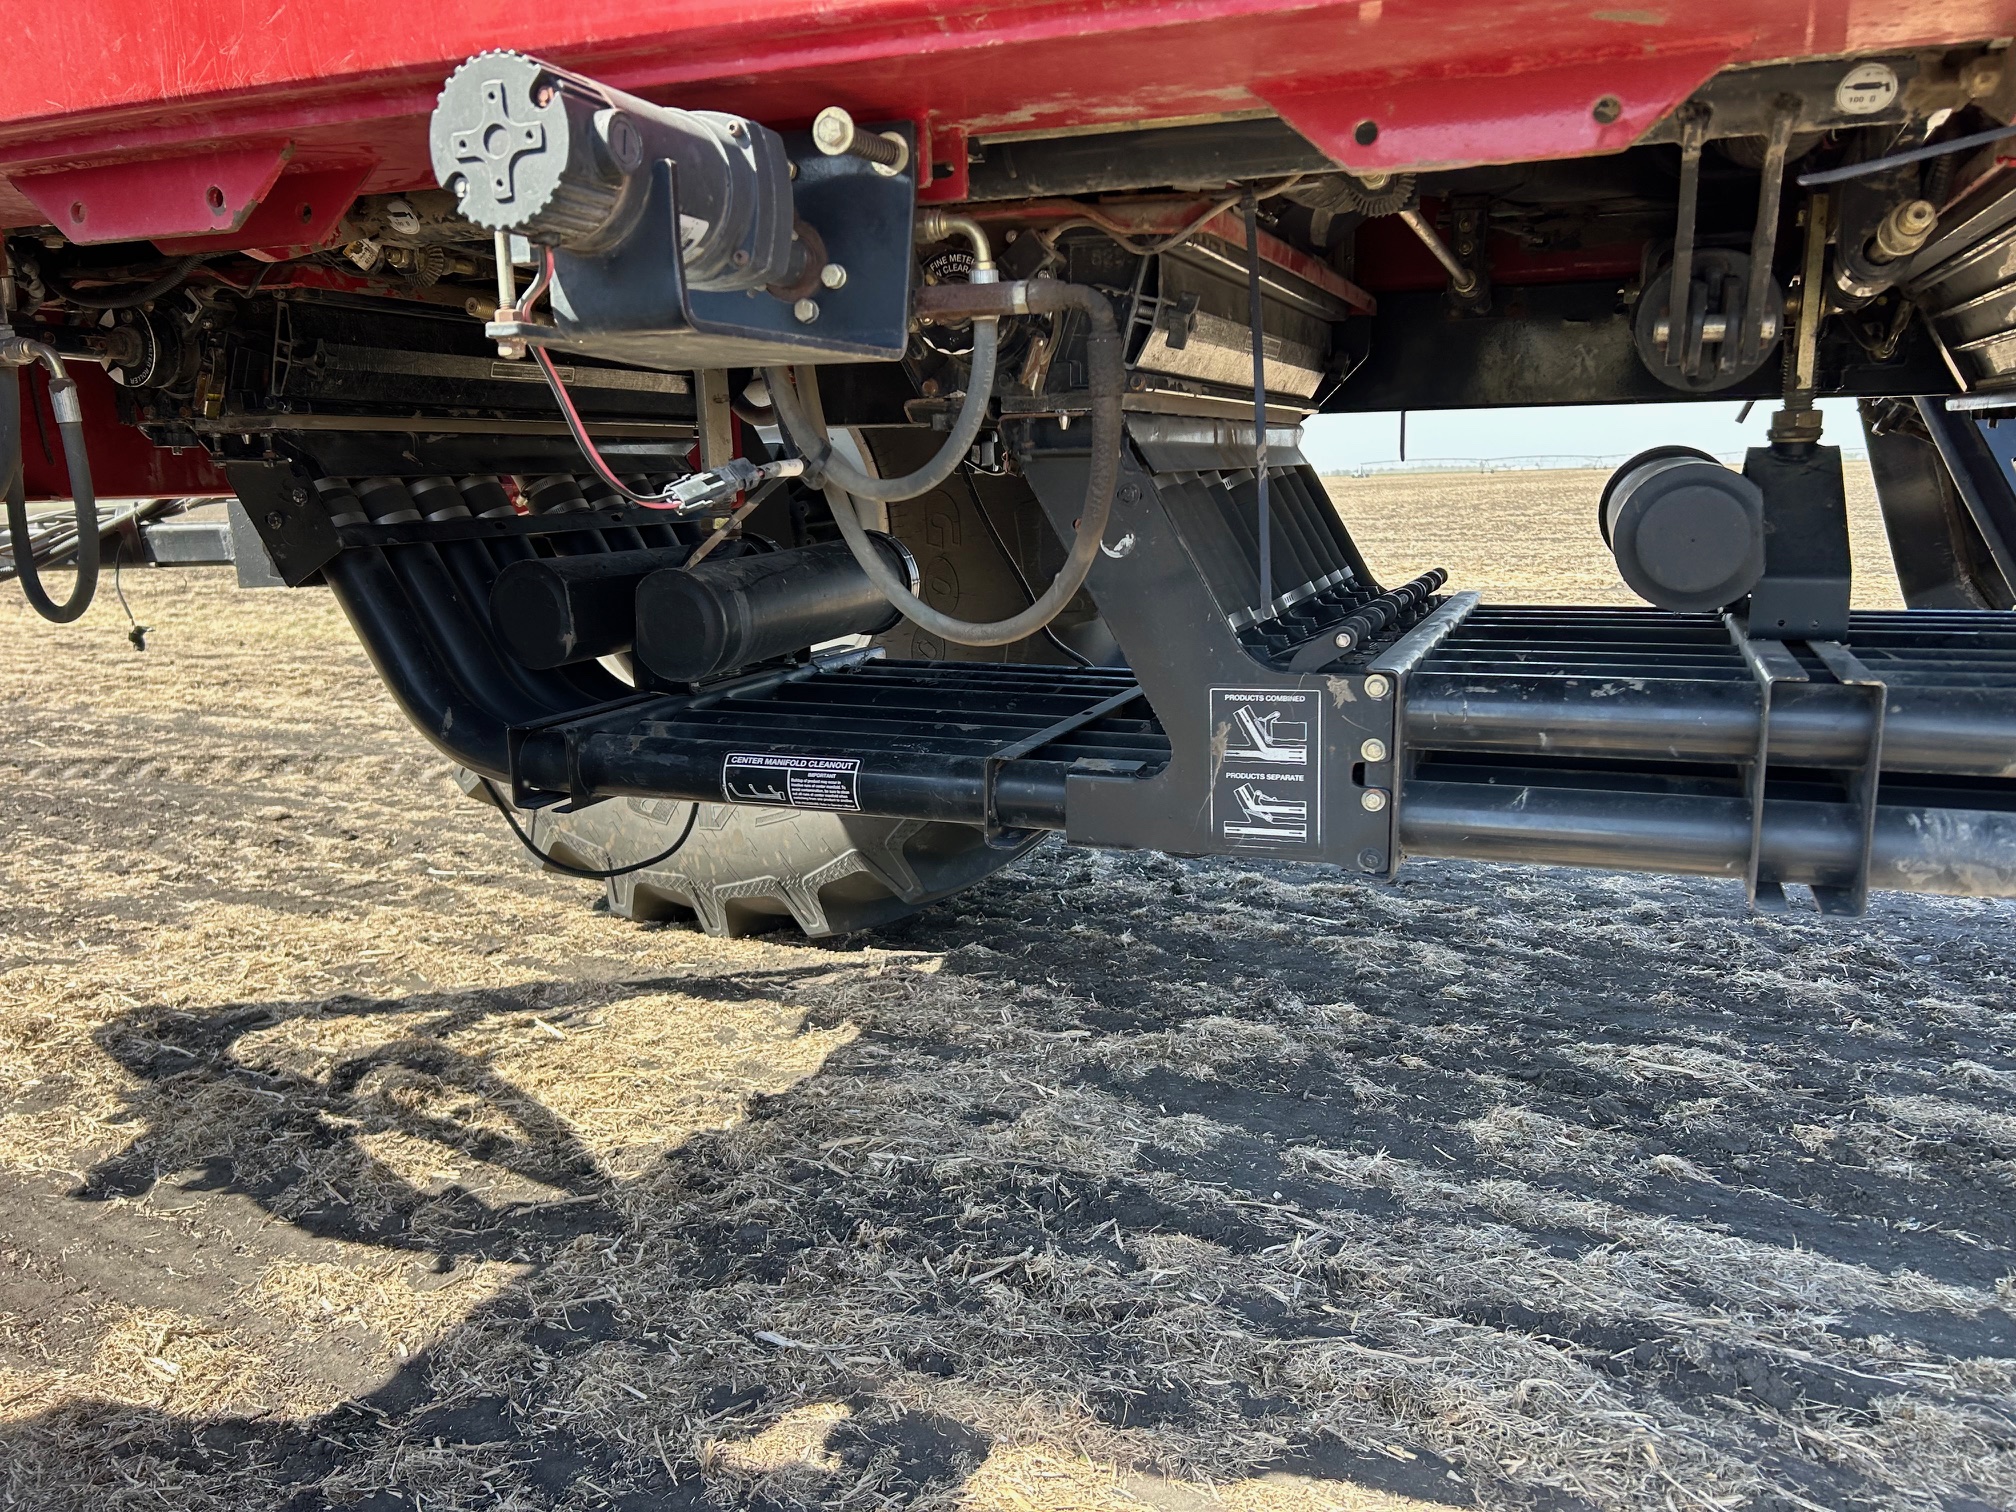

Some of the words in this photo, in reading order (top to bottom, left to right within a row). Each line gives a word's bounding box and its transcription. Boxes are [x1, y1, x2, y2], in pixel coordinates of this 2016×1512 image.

[929, 254, 948, 272] FINE
[130, 368, 149, 384] ROLLER
[1224, 694, 1265, 702] PRODUCTS
[731, 756, 763, 765] CENTER
[764, 758, 807, 767] MANIFOLD
[808, 760, 853, 770] CLEANOUT
[1225, 772, 1266, 780] PRODUCTS
[1266, 773, 1305, 782] SEPARATE
